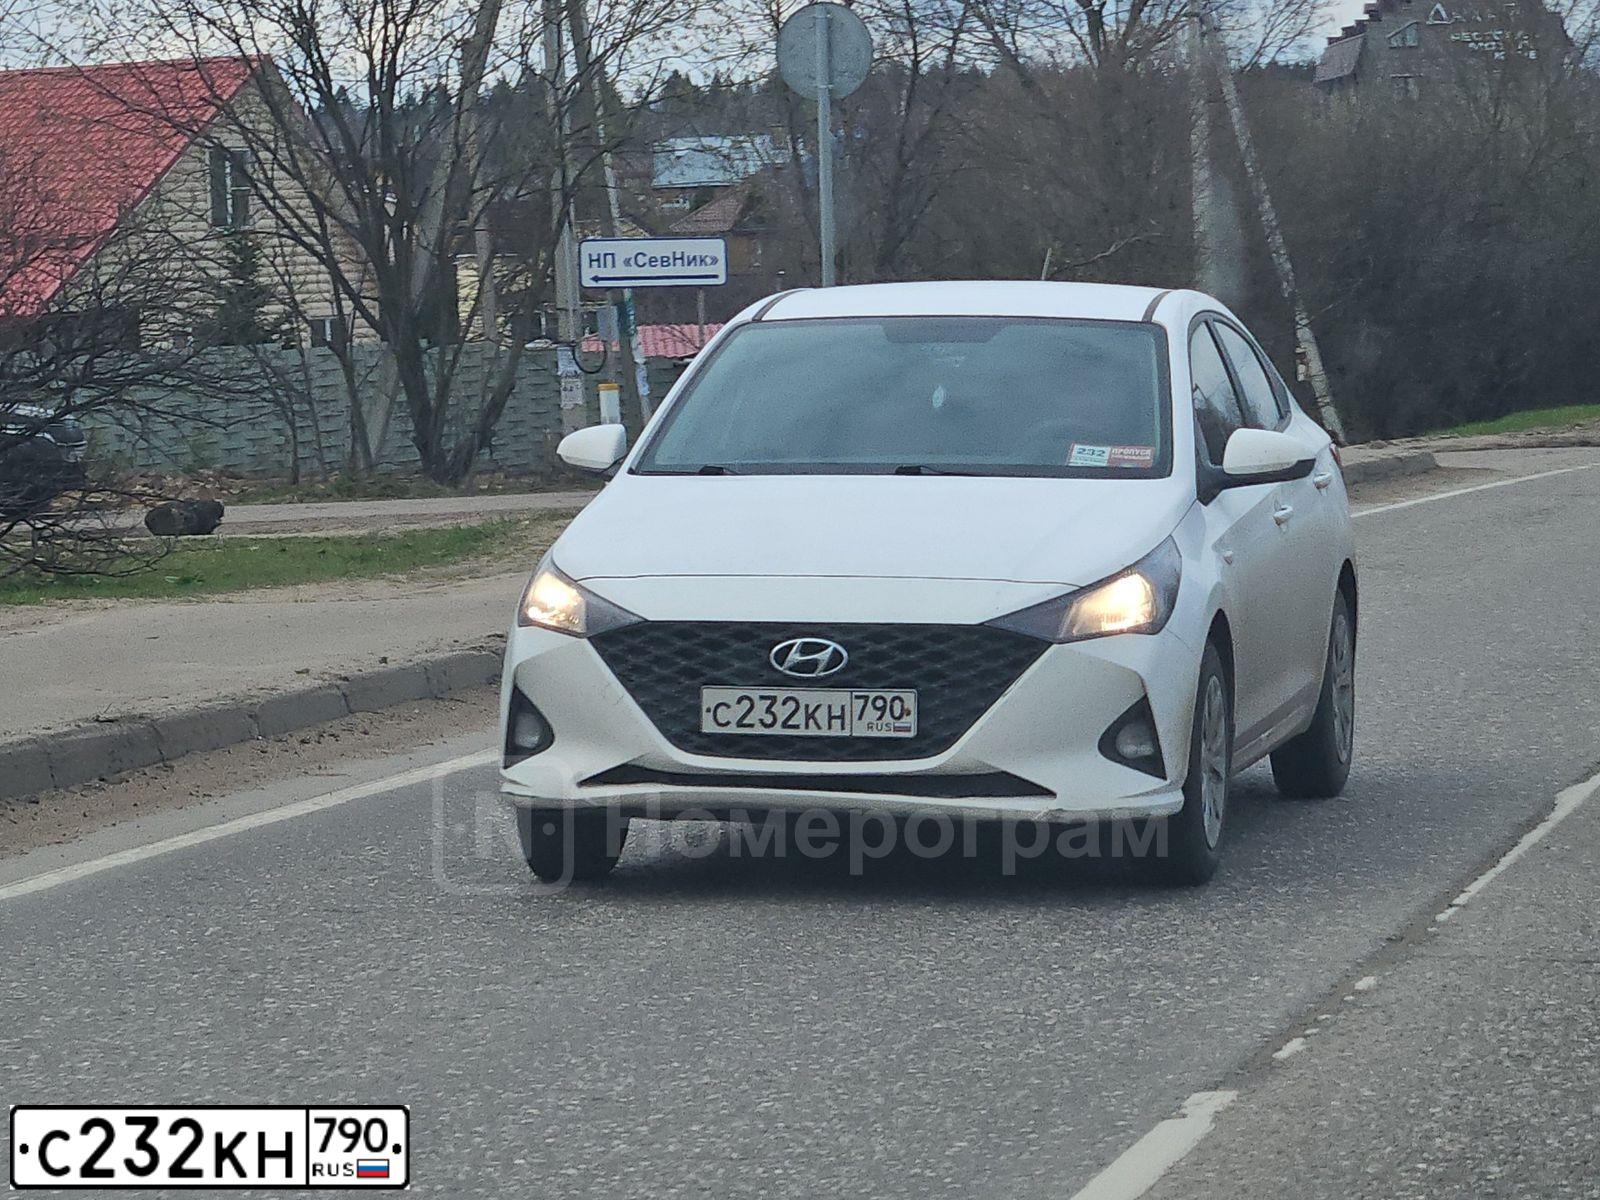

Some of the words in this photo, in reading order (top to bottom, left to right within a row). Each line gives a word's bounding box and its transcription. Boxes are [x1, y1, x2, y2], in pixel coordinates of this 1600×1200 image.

[588, 252, 616, 269] НП
[623, 250, 719, 268] «СевНик»
[1076, 447, 1106, 457] 232
[853, 694, 905, 721] 790
[866, 722, 892, 732] RUS
